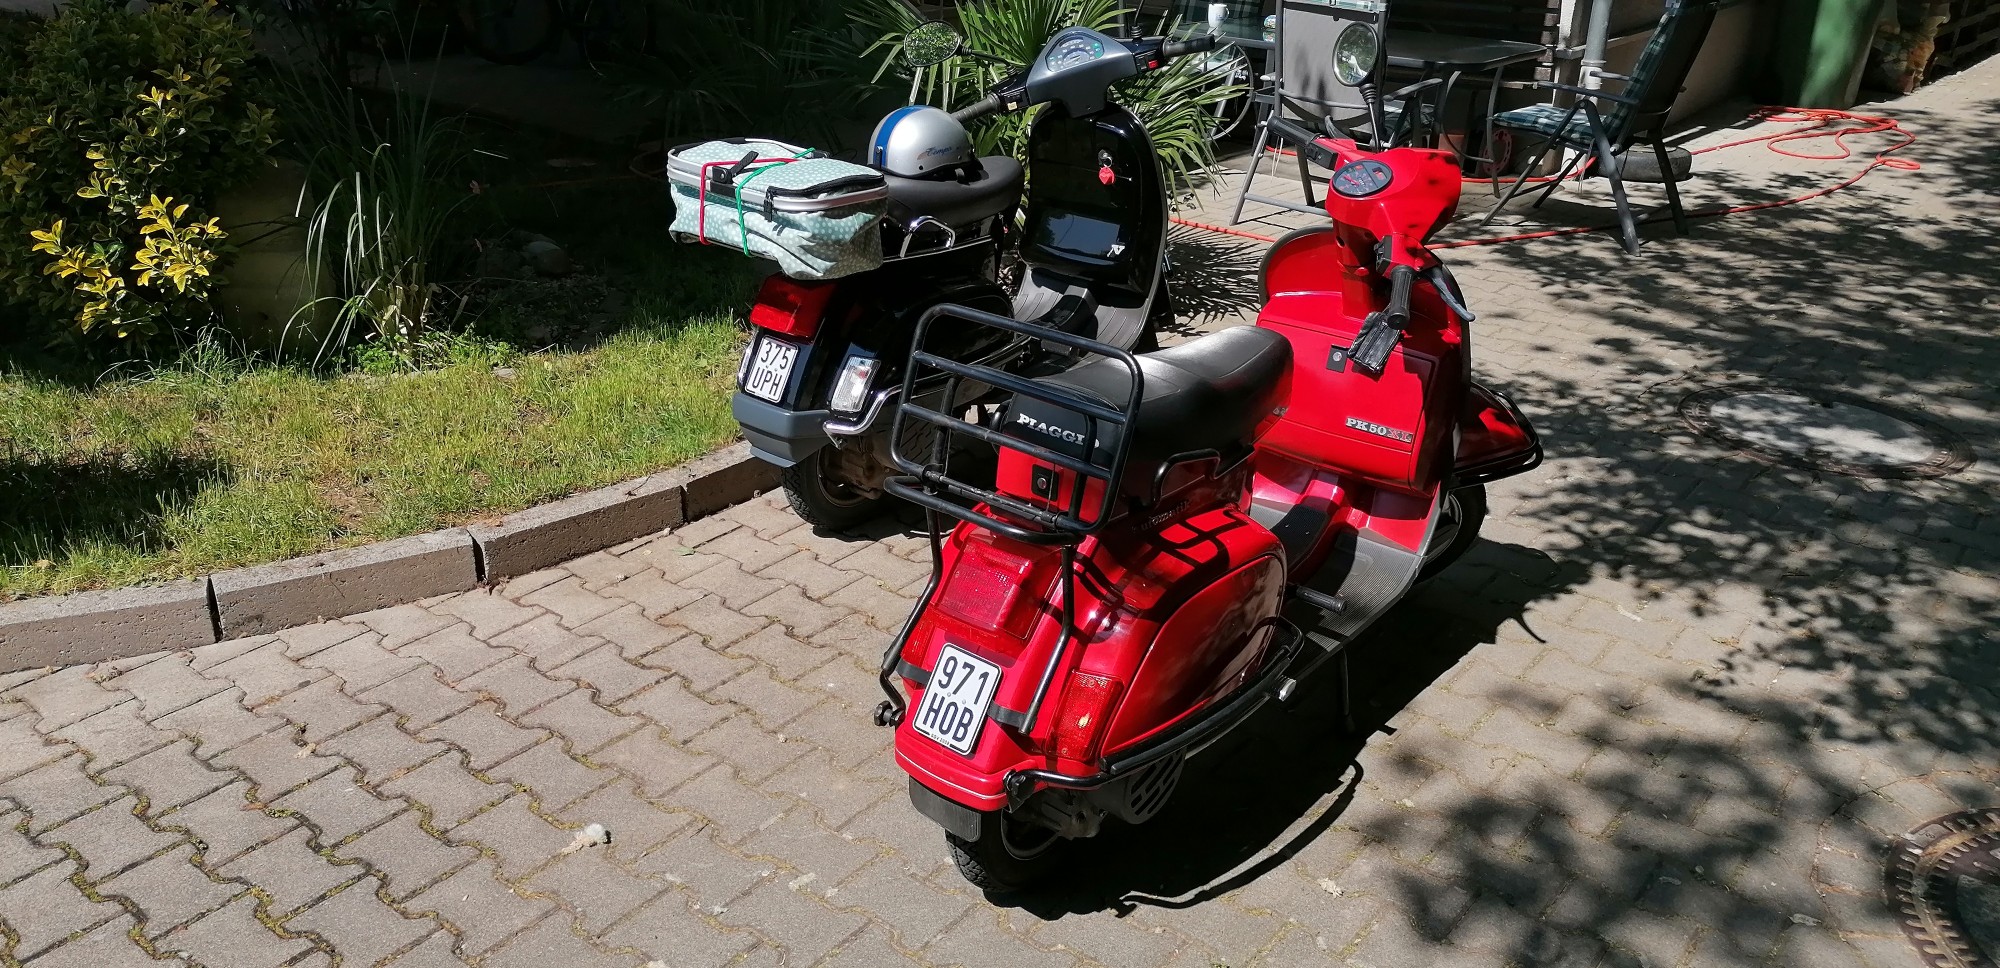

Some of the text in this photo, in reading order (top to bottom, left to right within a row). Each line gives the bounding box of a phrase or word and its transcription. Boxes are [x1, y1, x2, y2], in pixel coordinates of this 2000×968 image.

[761, 341, 791, 369] 375
[752, 366, 782, 396] UPH
[938, 656, 989, 704] 971
[923, 692, 973, 742] HOB
